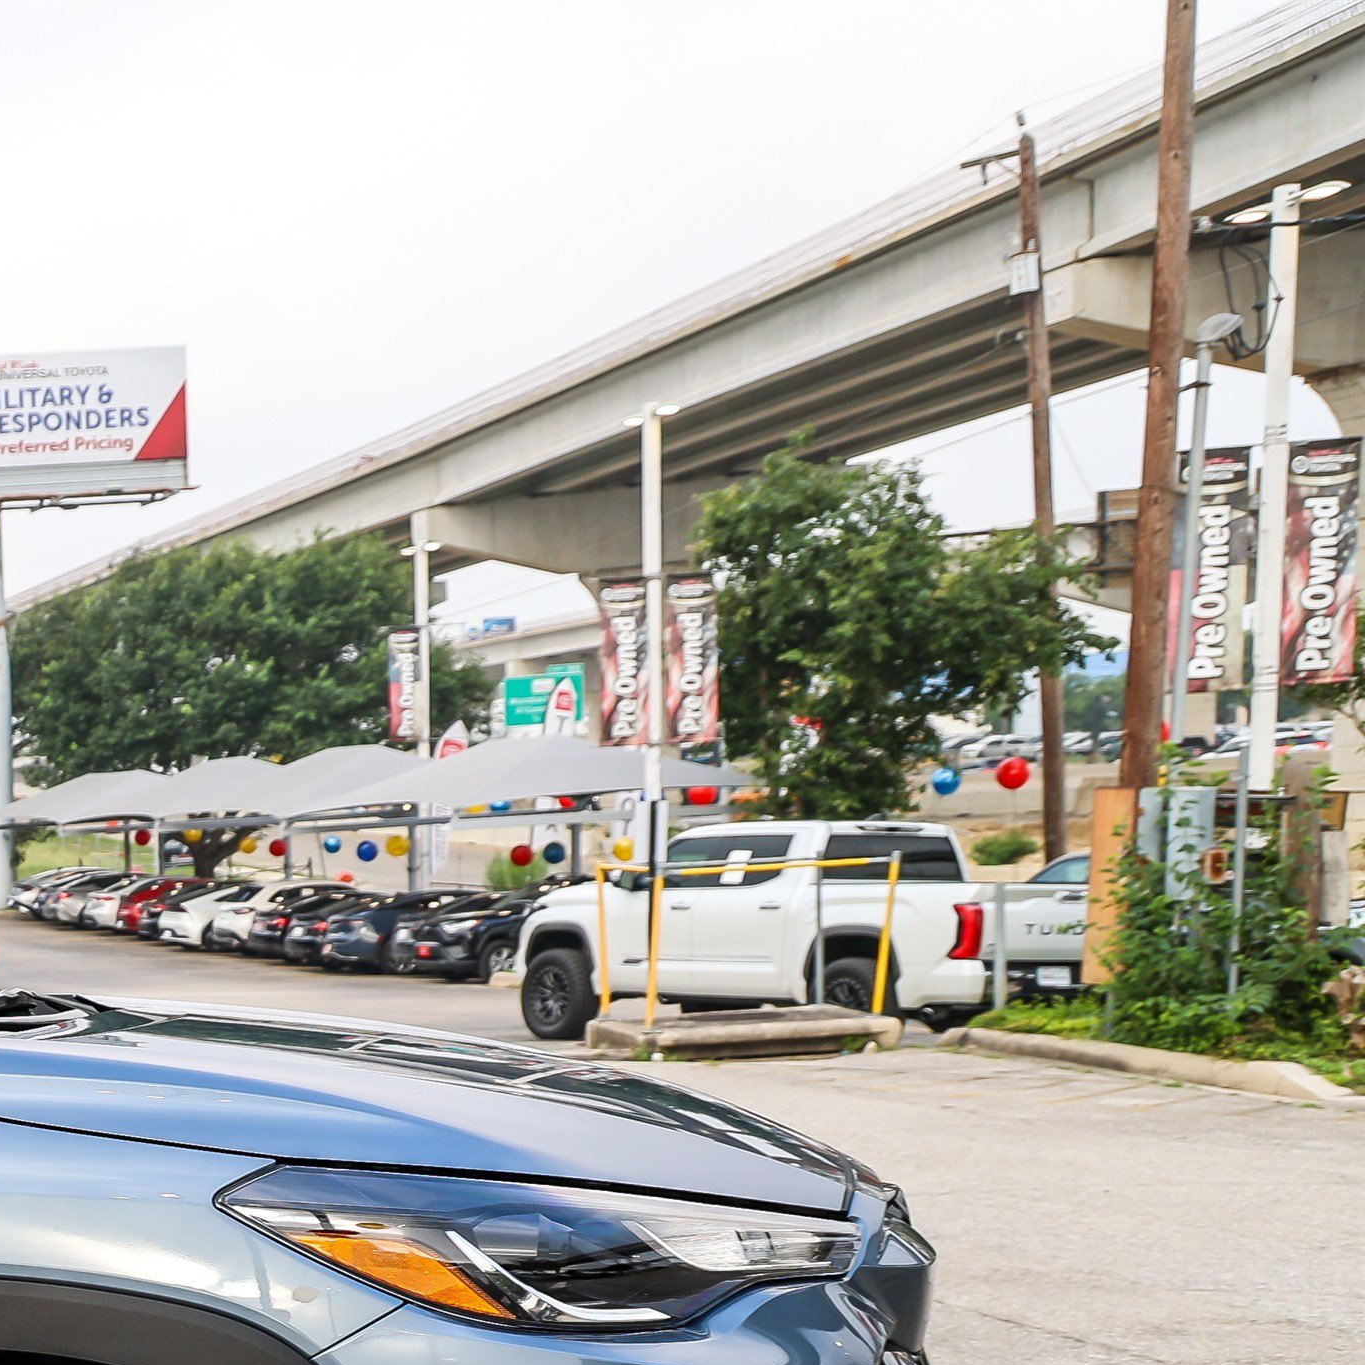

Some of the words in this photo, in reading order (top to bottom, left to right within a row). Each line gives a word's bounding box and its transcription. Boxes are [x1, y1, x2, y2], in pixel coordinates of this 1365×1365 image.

[64, 365, 110, 377] TOYOTA
[98, 382, 115, 404] &
[74, 435, 134, 453] Pricing
[1191, 504, 1232, 619] Owned
[1299, 495, 1341, 612] Owned
[610, 615, 638, 696] Owned
[676, 612, 703, 693] Owned
[1186, 622, 1226, 680] Pre
[1295, 613, 1334, 672] Pre
[610, 698, 638, 739] Pre
[676, 695, 703, 736] Pre
